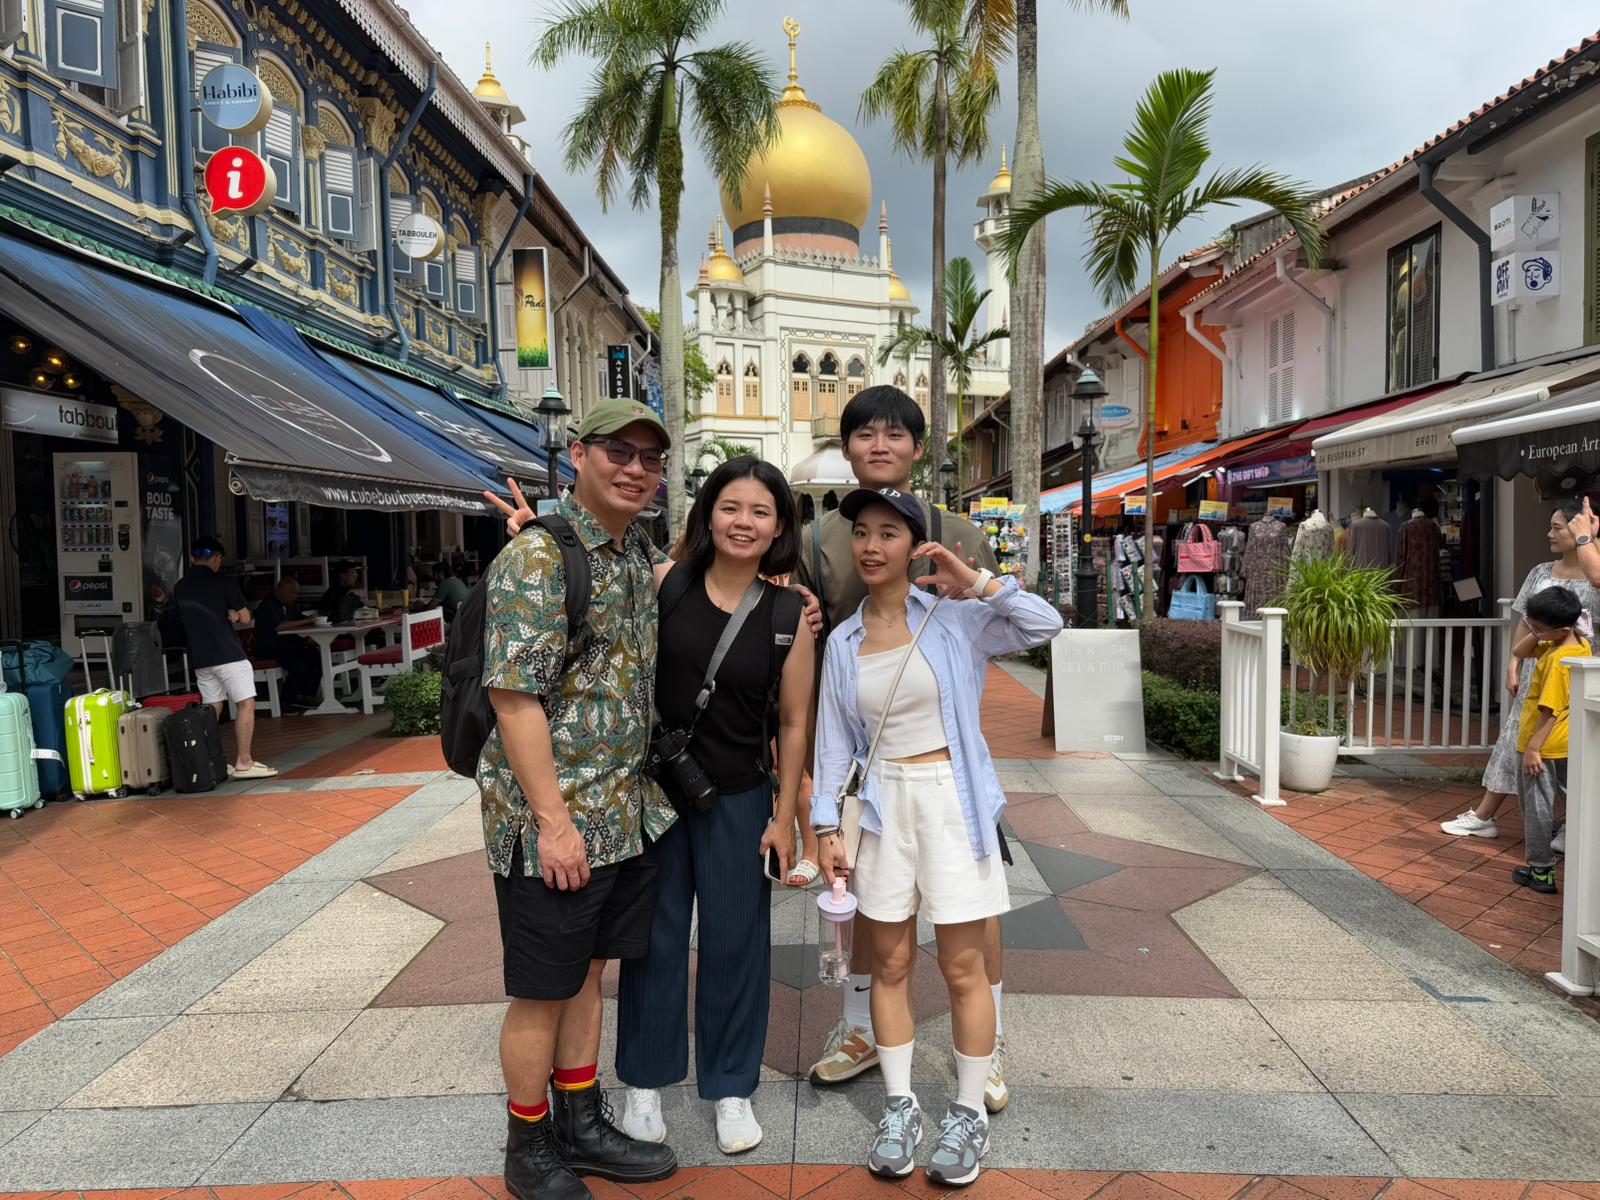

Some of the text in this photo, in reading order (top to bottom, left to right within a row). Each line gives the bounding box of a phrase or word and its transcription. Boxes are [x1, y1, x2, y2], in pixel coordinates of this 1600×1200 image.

[203, 82, 257, 99] Habibi
[398, 229, 438, 239] TABBOULEH
[1496, 260, 1510, 281] OFF
[1496, 277, 1510, 295] DAY
[1415, 434, 1438, 447] BROTI
[1327, 449, 1356, 463] BUSSORAH
[1357, 447, 1366, 457] ST
[1528, 442, 1578, 461] European
[146, 492, 172, 505] BOLD
[145, 506, 175, 520] TASTE
[82, 580, 108, 590] pepsi
